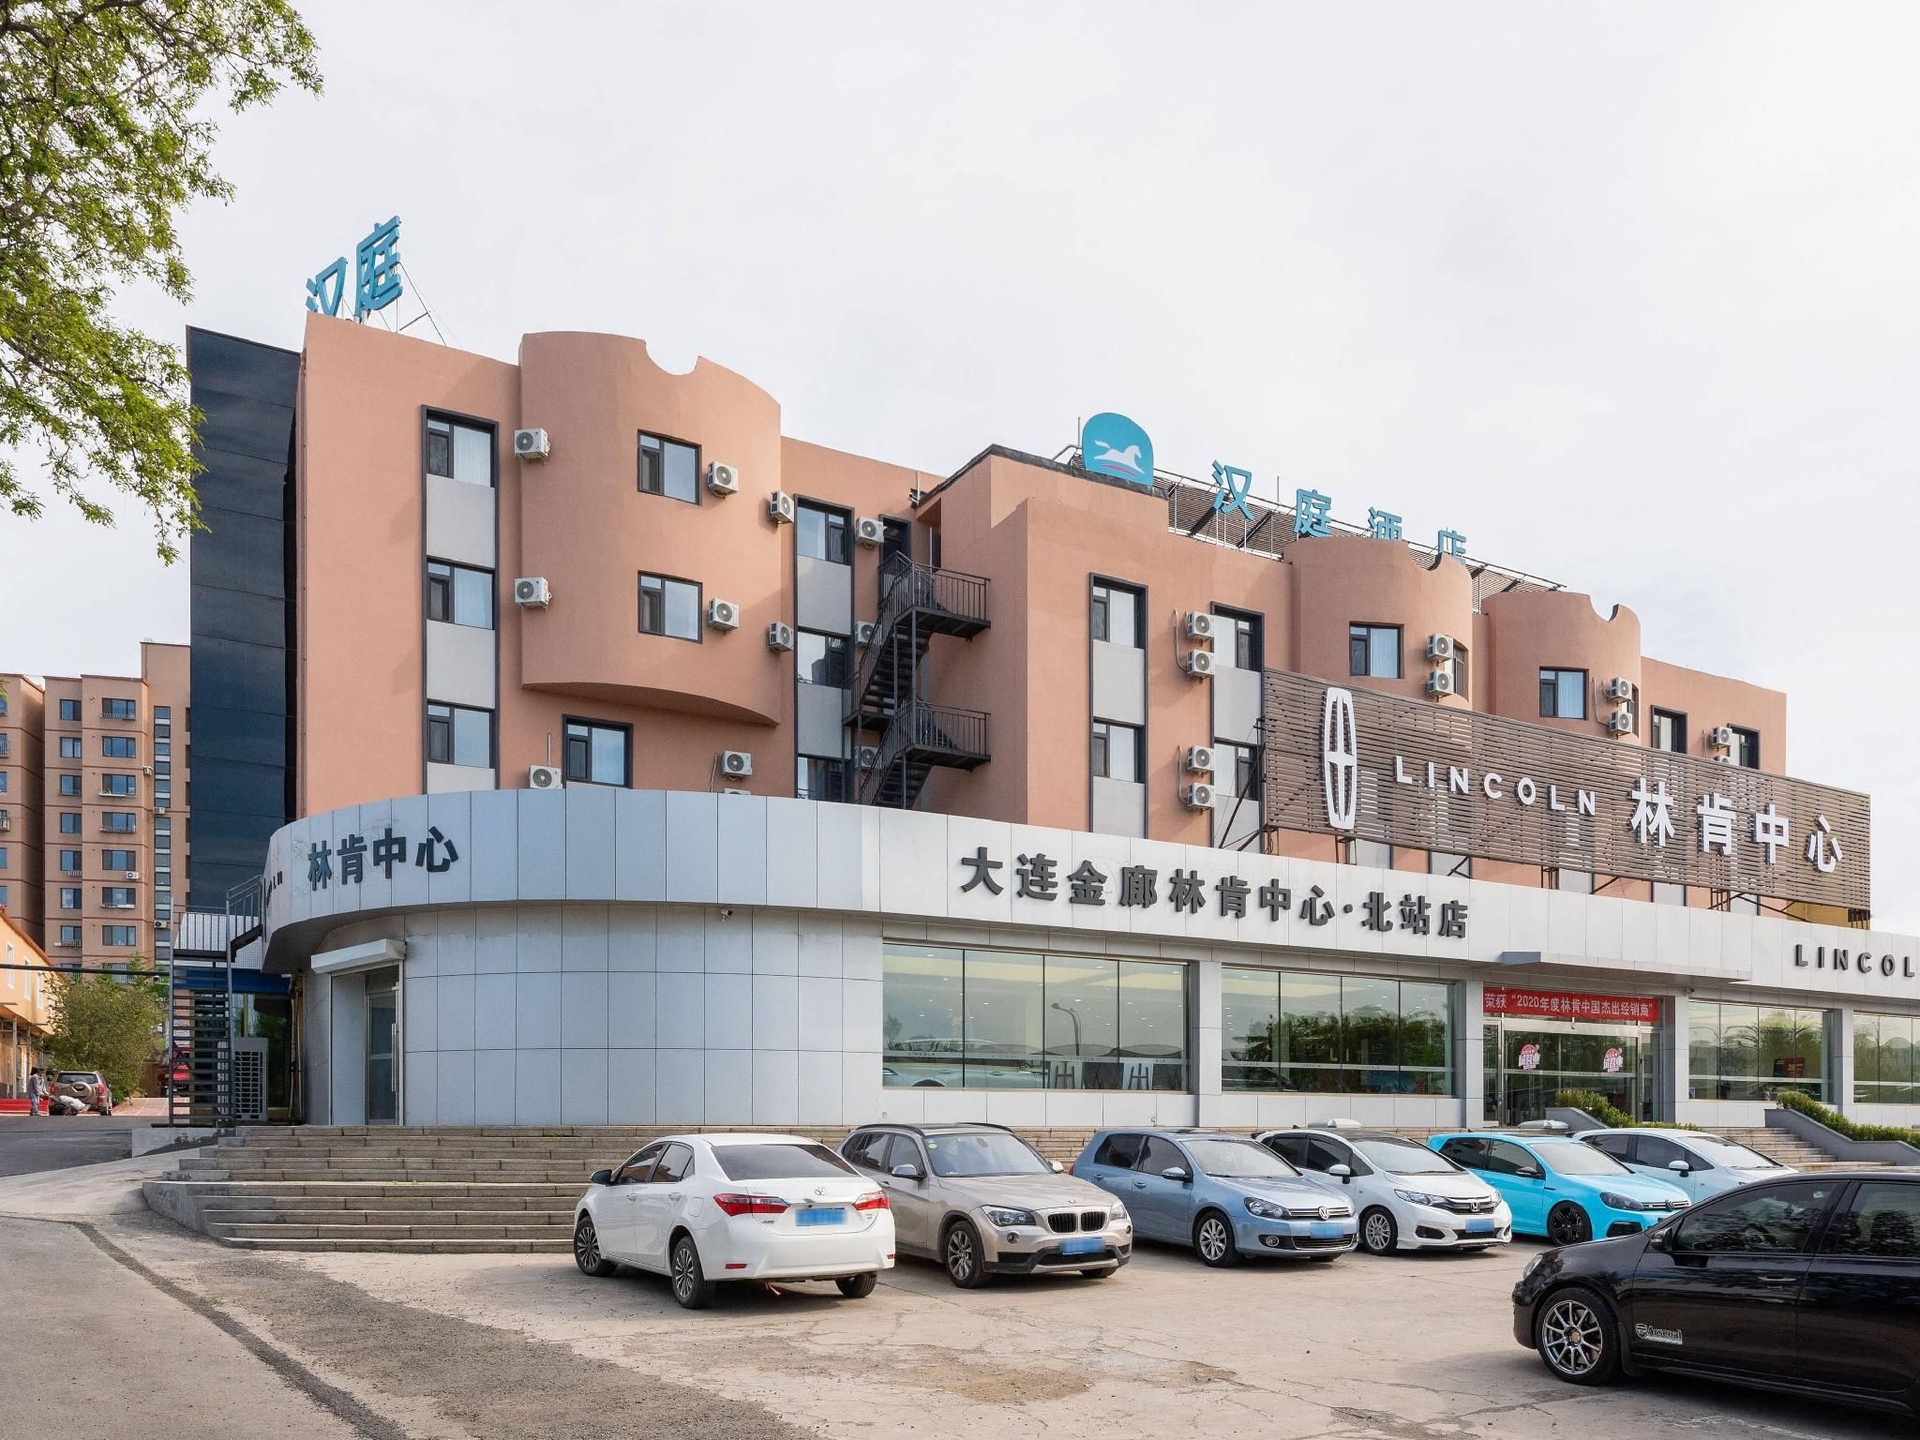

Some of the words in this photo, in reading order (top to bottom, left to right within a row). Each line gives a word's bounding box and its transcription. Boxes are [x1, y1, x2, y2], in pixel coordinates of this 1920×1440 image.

[305, 215, 403, 317] 汉庭
[307, 825, 459, 892] 林肯中心
[1393, 755, 1596, 816] LINCOLN
[1627, 777, 1843, 873] 林肯中心
[960, 846, 1468, 939] 大连金廊林肯中心·北站店
[1485, 993, 1507, 1009] 荣获
